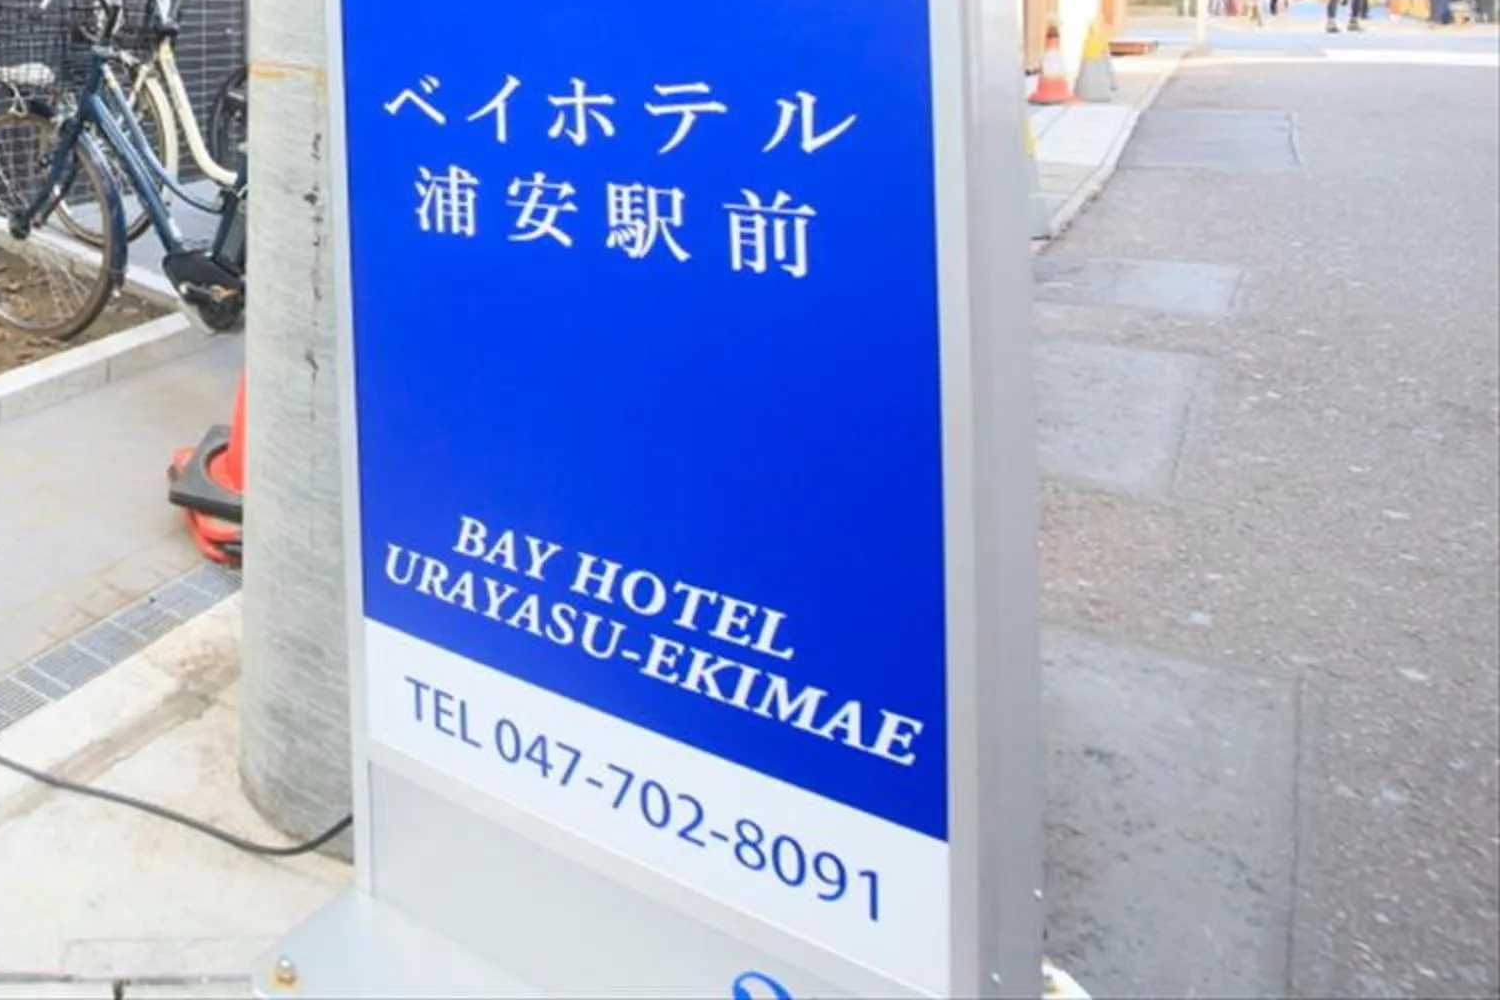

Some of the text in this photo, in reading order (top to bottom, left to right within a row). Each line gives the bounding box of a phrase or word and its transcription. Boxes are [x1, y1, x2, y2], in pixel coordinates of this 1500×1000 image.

[384, 74, 858, 155] ベイホテル
[414, 165, 817, 277] 浦安駅前
[384, 542, 924, 767] URAYASU-EKIMAE
[452, 515, 795, 661] BAY HOTEL
[404, 676, 880, 922] TEL 047-702-8091
